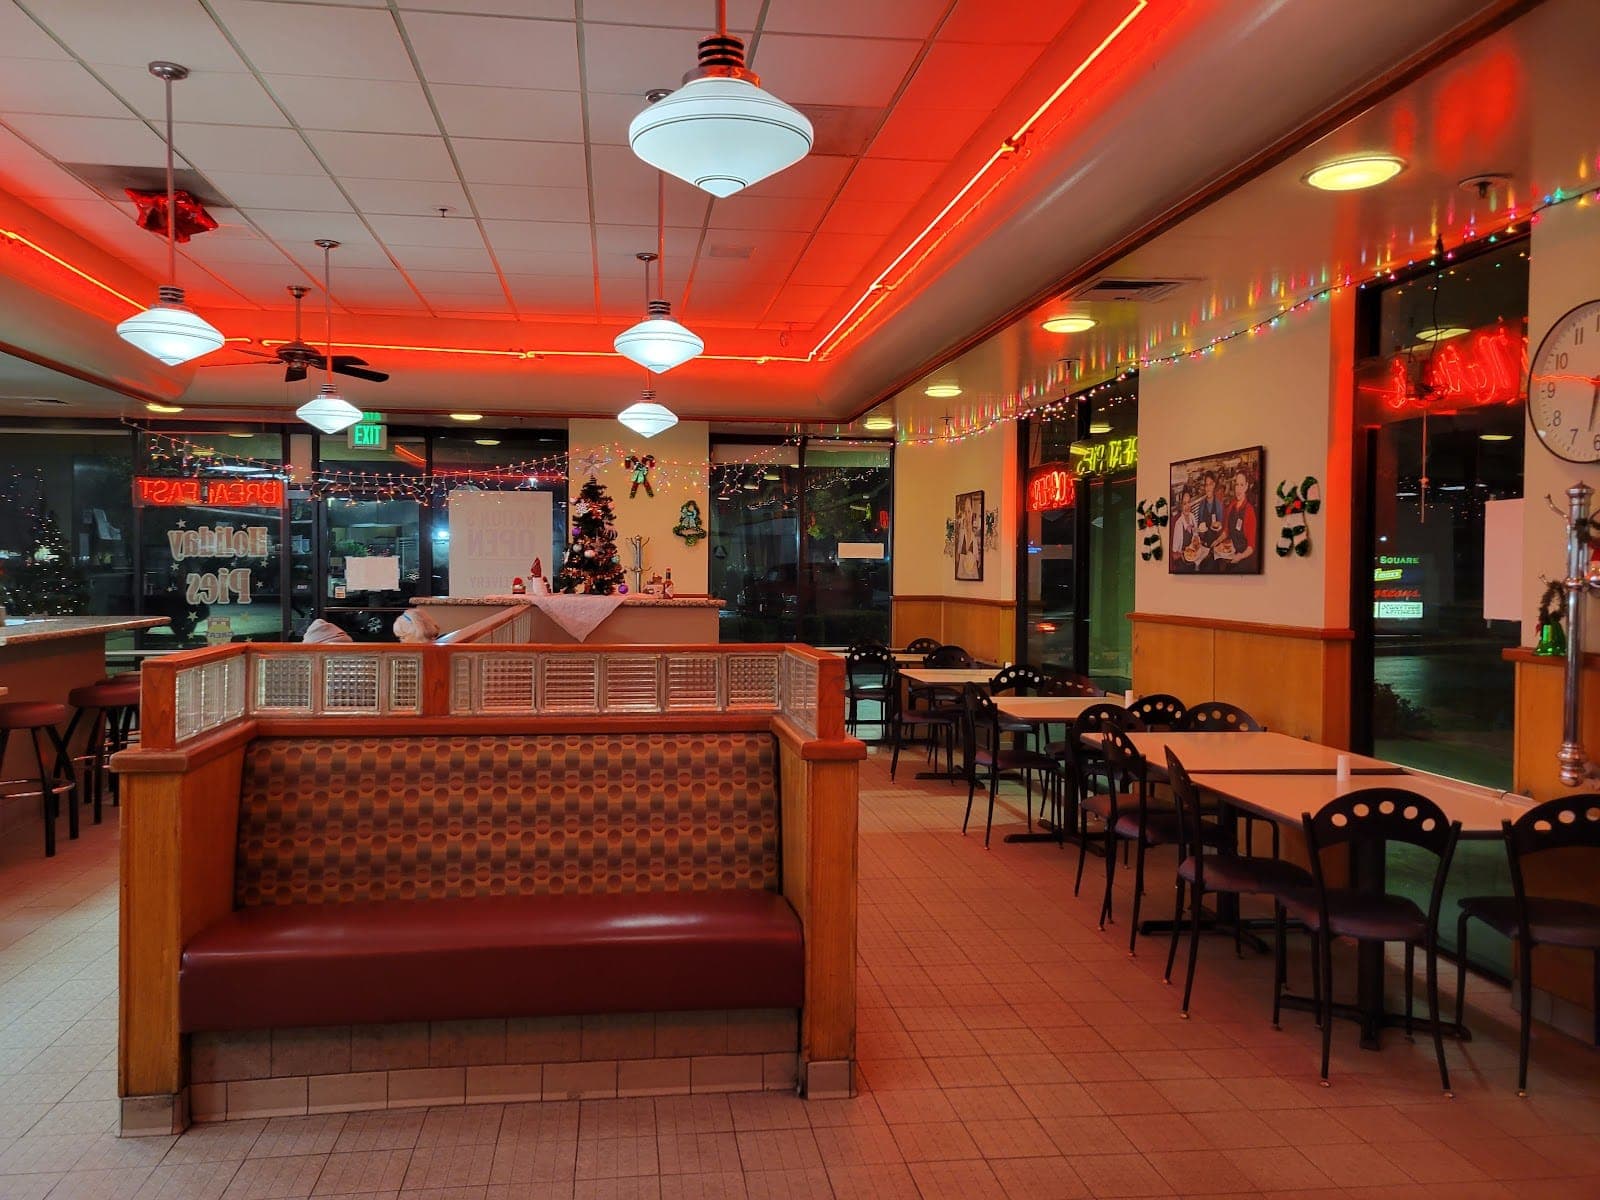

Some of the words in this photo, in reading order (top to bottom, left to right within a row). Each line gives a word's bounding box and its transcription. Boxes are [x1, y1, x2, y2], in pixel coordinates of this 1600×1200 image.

[1574, 327, 1584, 345] 11
[1555, 352, 1568, 370] 10
[1547, 382, 1556, 398] 9
[1552, 409, 1562, 427] 8
[354, 425, 382, 445] EXIT
[1570, 428, 1579, 445] 7
[1593, 434, 1600, 451] 6
